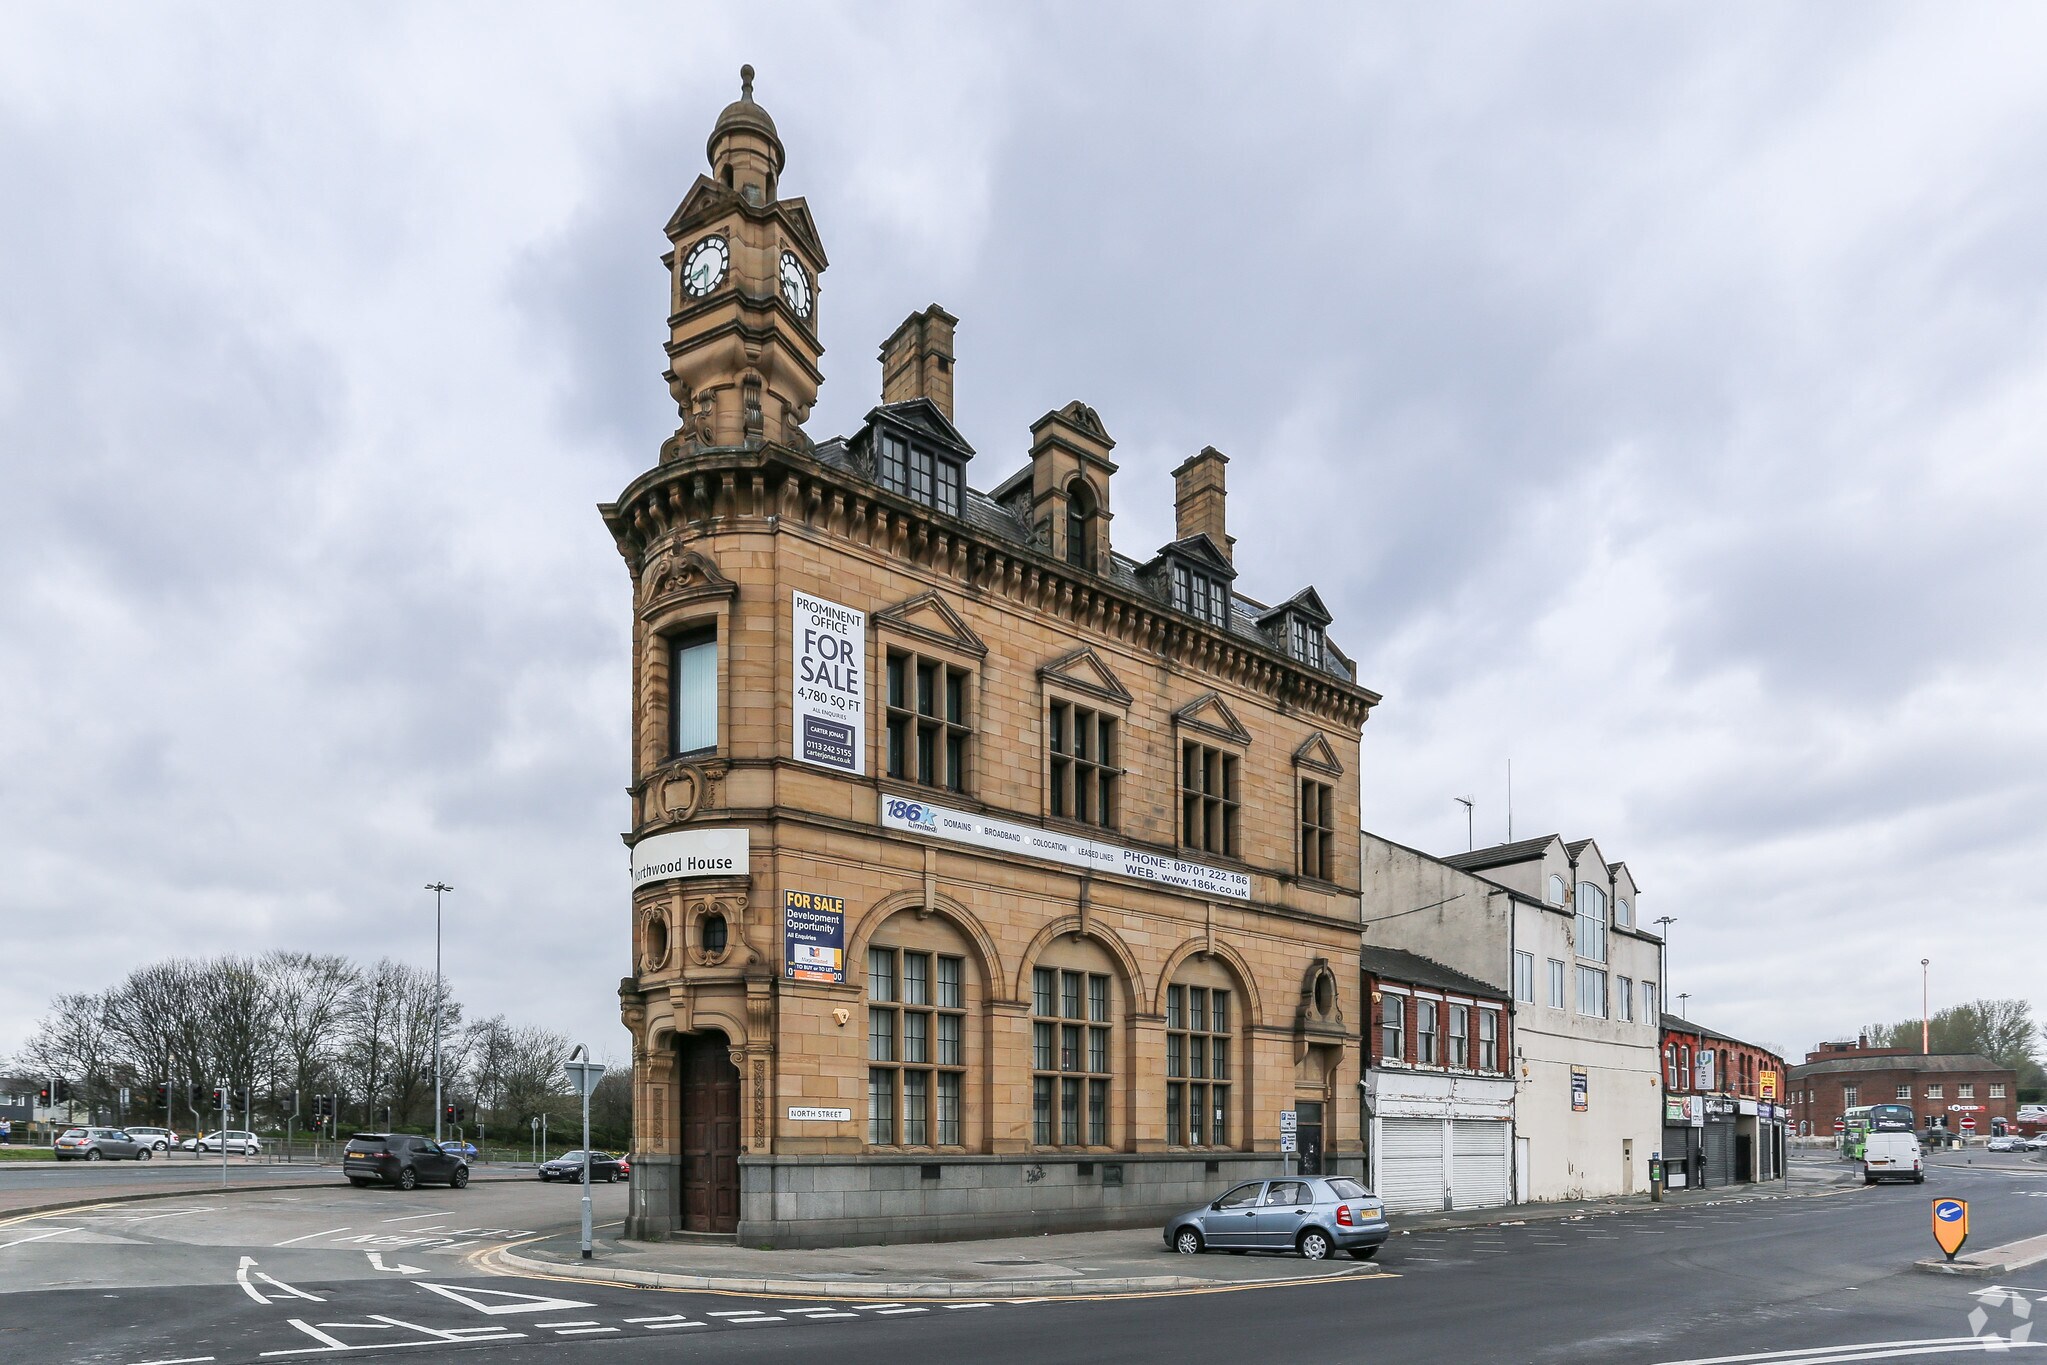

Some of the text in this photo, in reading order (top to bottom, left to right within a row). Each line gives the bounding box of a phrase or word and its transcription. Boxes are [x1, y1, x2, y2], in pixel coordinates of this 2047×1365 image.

[796, 597, 862, 627] PROMINENT
[811, 614, 848, 636] OFFICE
[804, 628, 855, 668] FOR
[800, 656, 858, 695] SALE
[797, 687, 861, 713] 4,780 SQ FT
[822, 709, 847, 720] ENQUIRIES
[810, 726, 845, 739] CARTER JONAS
[806, 740, 852, 757] 0113 242 5155
[806, 750, 851, 764] carterjonas.co.uk
[908, 821, 938, 834] Limited
[943, 818, 1114, 862] DOMAINS BROADBAND COLOCATION LEASED LINES
[687, 856, 733, 871] House
[1123, 850, 1248, 885] PHONE: 08701 222 186
[1125, 864, 1247, 897] WEB: www.186k.co.uk
[786, 891, 843, 913] FOR SALE
[787, 908, 840, 924] Development
[786, 919, 835, 935] Opportunity
[795, 932, 816, 941] Enquiries
[817, 1110, 842, 1118] STREET
